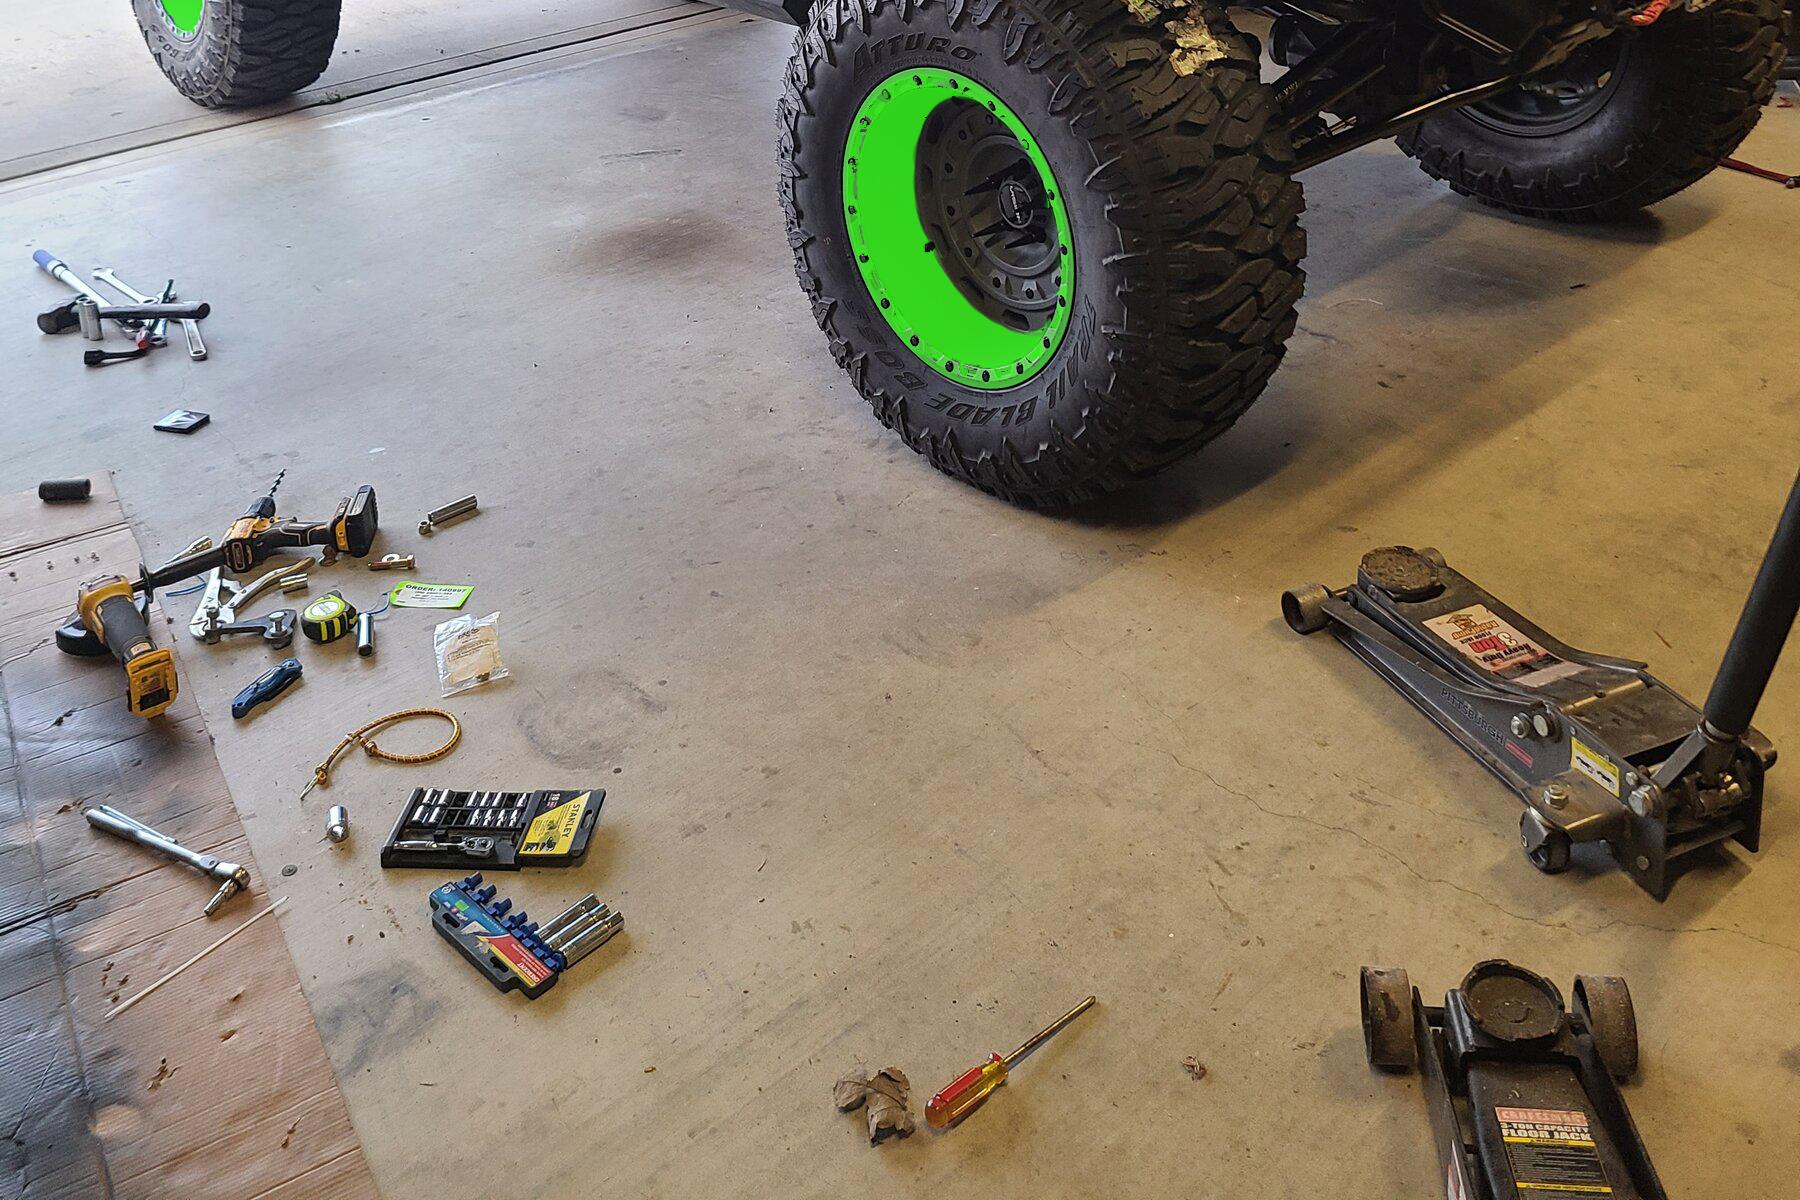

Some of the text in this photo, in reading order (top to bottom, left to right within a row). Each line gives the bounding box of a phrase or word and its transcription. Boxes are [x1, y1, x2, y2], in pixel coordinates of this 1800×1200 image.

[853, 31, 978, 84] ATTURO
[841, 294, 1097, 427] TRAIL BLADE BOSS
[1441, 688, 1505, 745] PITTSBURGH
[562, 803, 580, 838] STANLEY
[1502, 1128, 1592, 1141] FLOOR JACK
[1535, 1123, 1589, 1133] CAPACITY
